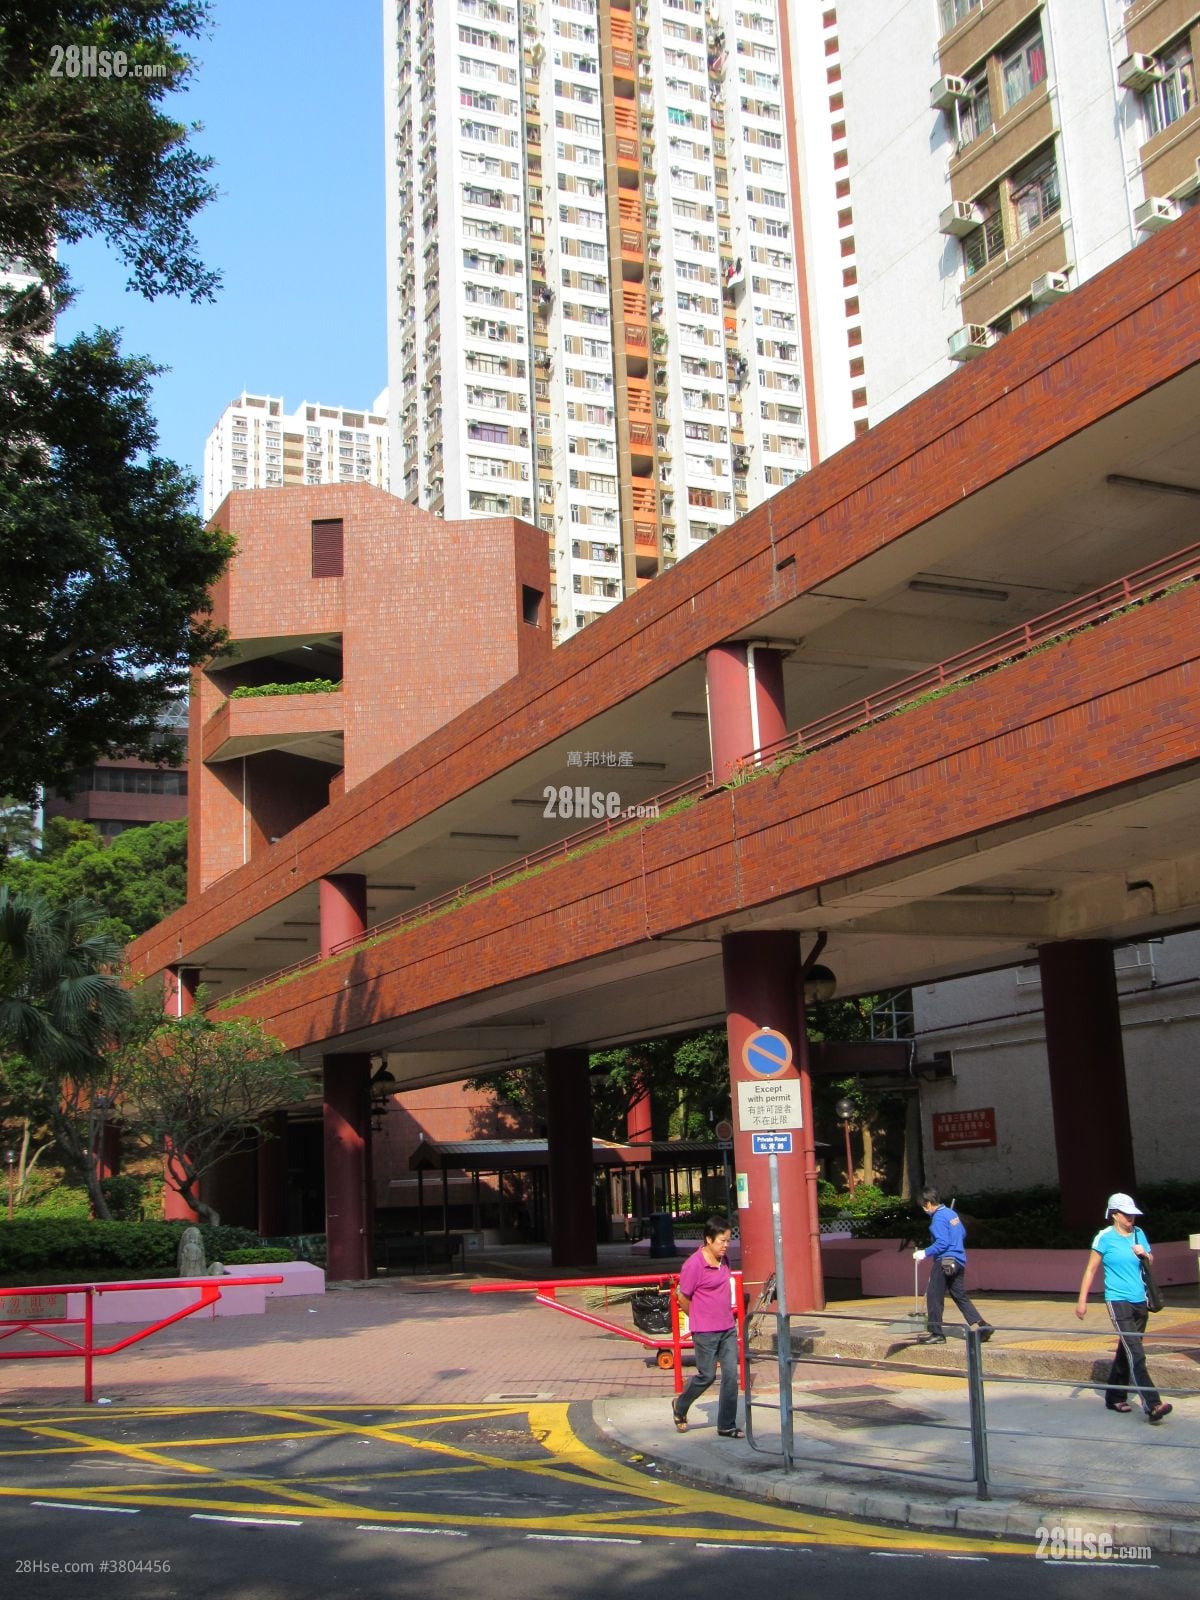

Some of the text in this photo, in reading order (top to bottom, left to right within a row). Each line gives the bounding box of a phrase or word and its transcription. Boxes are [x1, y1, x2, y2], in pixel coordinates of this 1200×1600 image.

[755, 1085, 782, 1094] Except
[747, 1094, 791, 1103] with permit
[748, 1104, 792, 1114] 有許可證者
[752, 1115, 788, 1125] 不在此限
